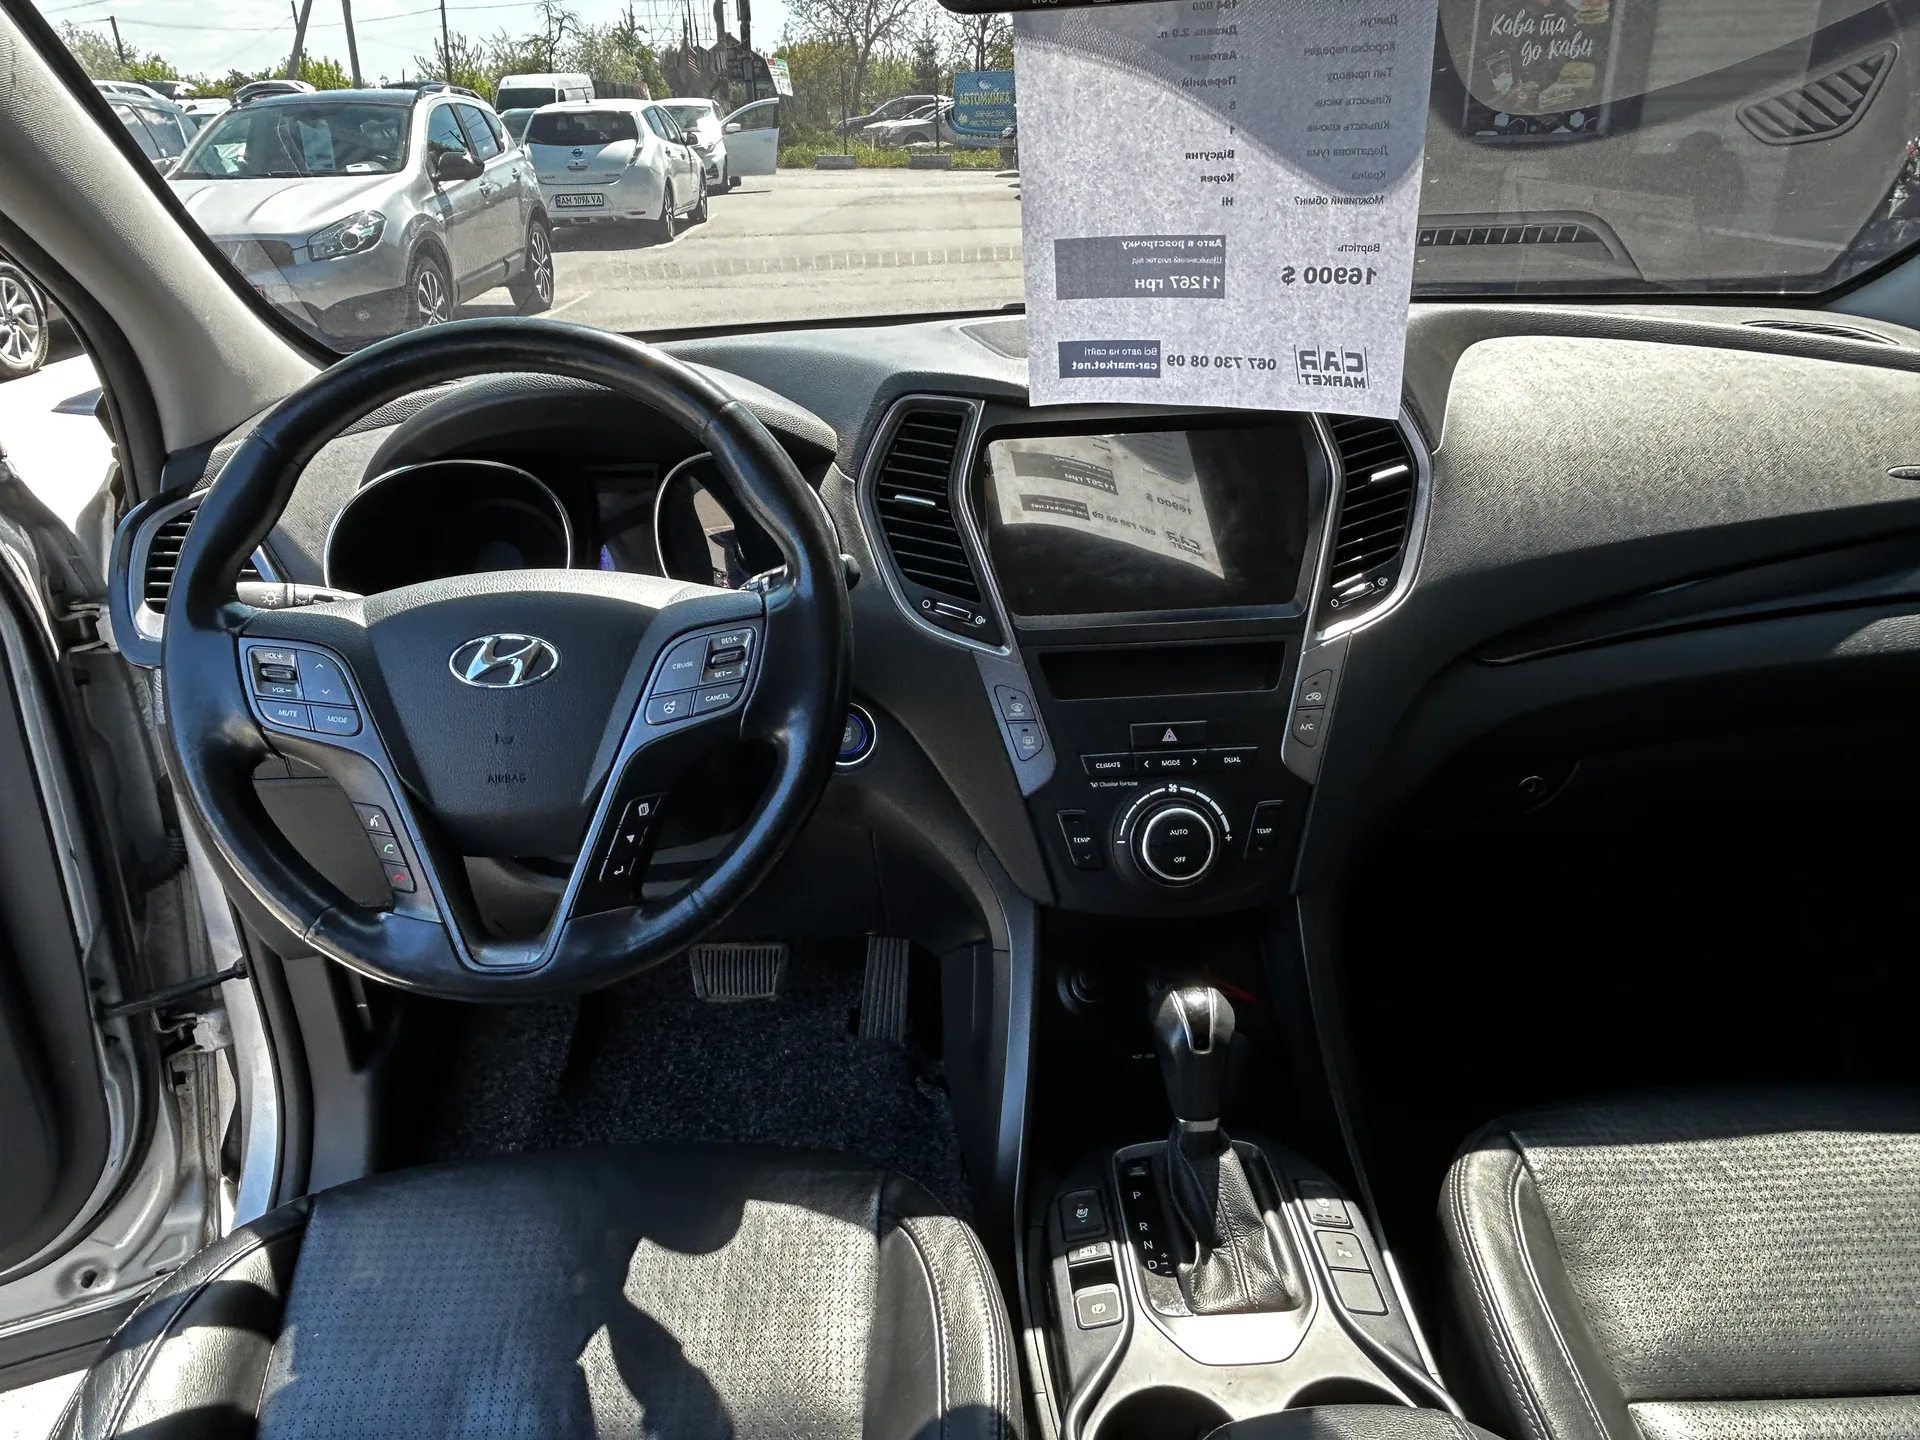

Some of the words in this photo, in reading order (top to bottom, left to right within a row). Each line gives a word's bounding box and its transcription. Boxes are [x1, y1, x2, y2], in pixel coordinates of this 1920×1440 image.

[1490, 9, 1536, 38] Кава
[1540, 13, 1568, 36] та
[1521, 39, 1542, 66] до
[1547, 30, 1593, 59] кави
[672, 661, 693, 669] CRUISE
[705, 693, 731, 702] CANCEL
[1299, 723, 1314, 731] A/C
[1161, 759, 1180, 767] MODE
[1223, 756, 1241, 764] DUAL
[1095, 761, 1121, 769] CLIMATE
[488, 772, 527, 784] AIRBAG
[1169, 828, 1188, 836] AUTO
[1256, 827, 1273, 835] TEMP
[1073, 836, 1091, 844] TEMP
[1173, 856, 1186, 864] OFF
[1132, 1191, 1141, 1200] P
[1139, 1222, 1148, 1231] R
[1143, 1240, 1154, 1250] N
[1147, 1260, 1158, 1270] D
